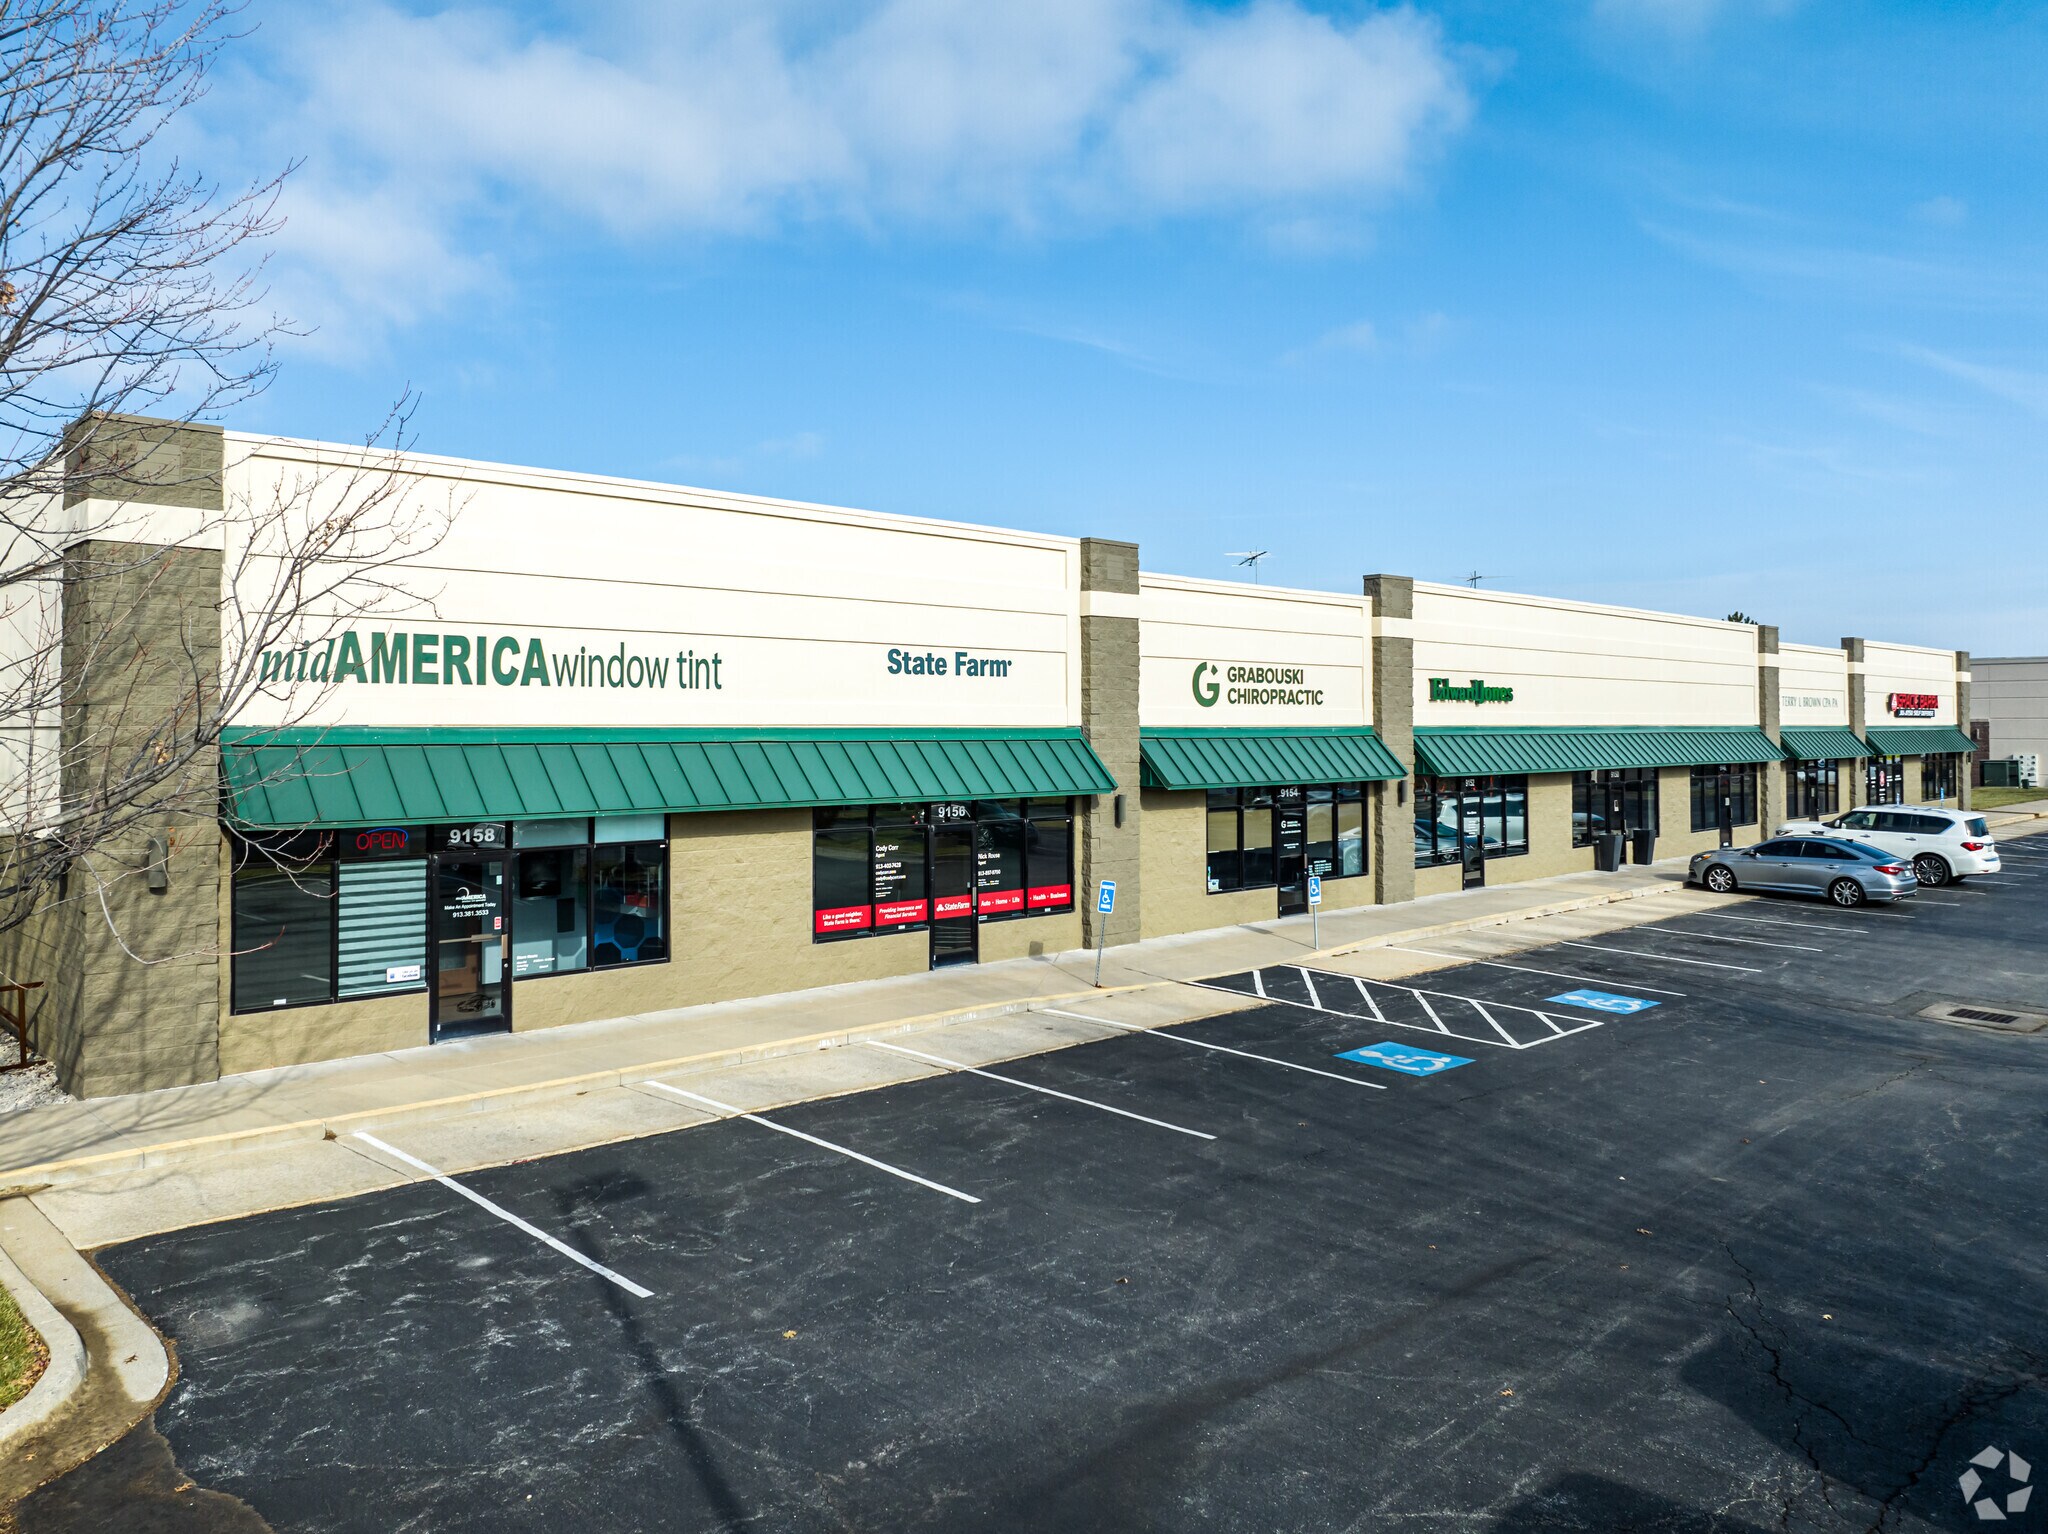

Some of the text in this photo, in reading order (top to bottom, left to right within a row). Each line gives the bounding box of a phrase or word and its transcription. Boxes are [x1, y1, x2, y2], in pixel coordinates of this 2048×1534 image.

[552, 642, 669, 688] window
[677, 650, 722, 690] tint
[887, 648, 1007, 677] State Farm
[1227, 666, 1304, 685] GRABOUSKI
[1227, 687, 1324, 706] CHIROPRACTIC
[1781, 696, 1797, 707] TERRY
[1803, 696, 1821, 707] BROWN
[1280, 788, 1298, 798] 9154
[938, 805, 966, 818] 9156
[356, 832, 405, 850] OPEN
[449, 828, 495, 844] 9158
